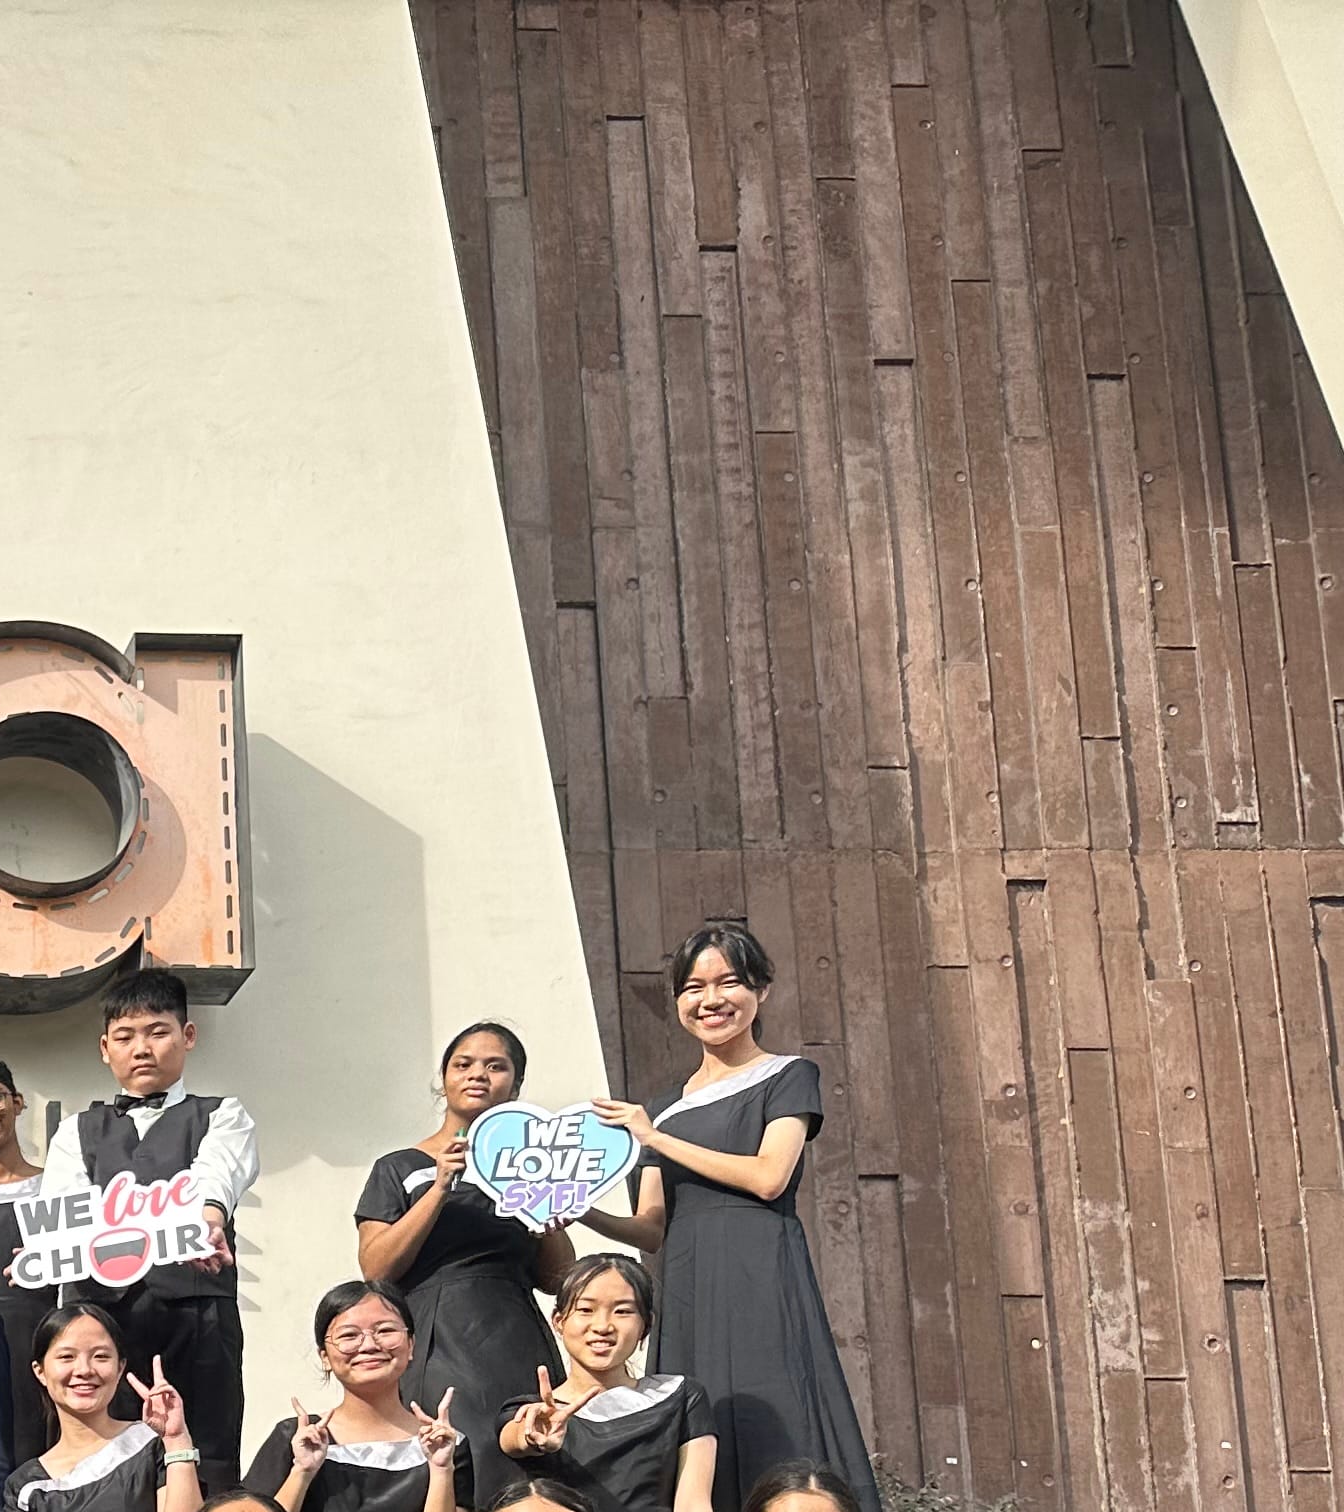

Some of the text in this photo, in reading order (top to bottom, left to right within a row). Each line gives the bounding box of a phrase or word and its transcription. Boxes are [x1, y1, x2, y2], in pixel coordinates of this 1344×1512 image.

[523, 1114, 585, 1147] WE
[490, 1146, 606, 1182] LOVE
[20, 1175, 199, 1236] WE love
[500, 1182, 588, 1214] SYF!
